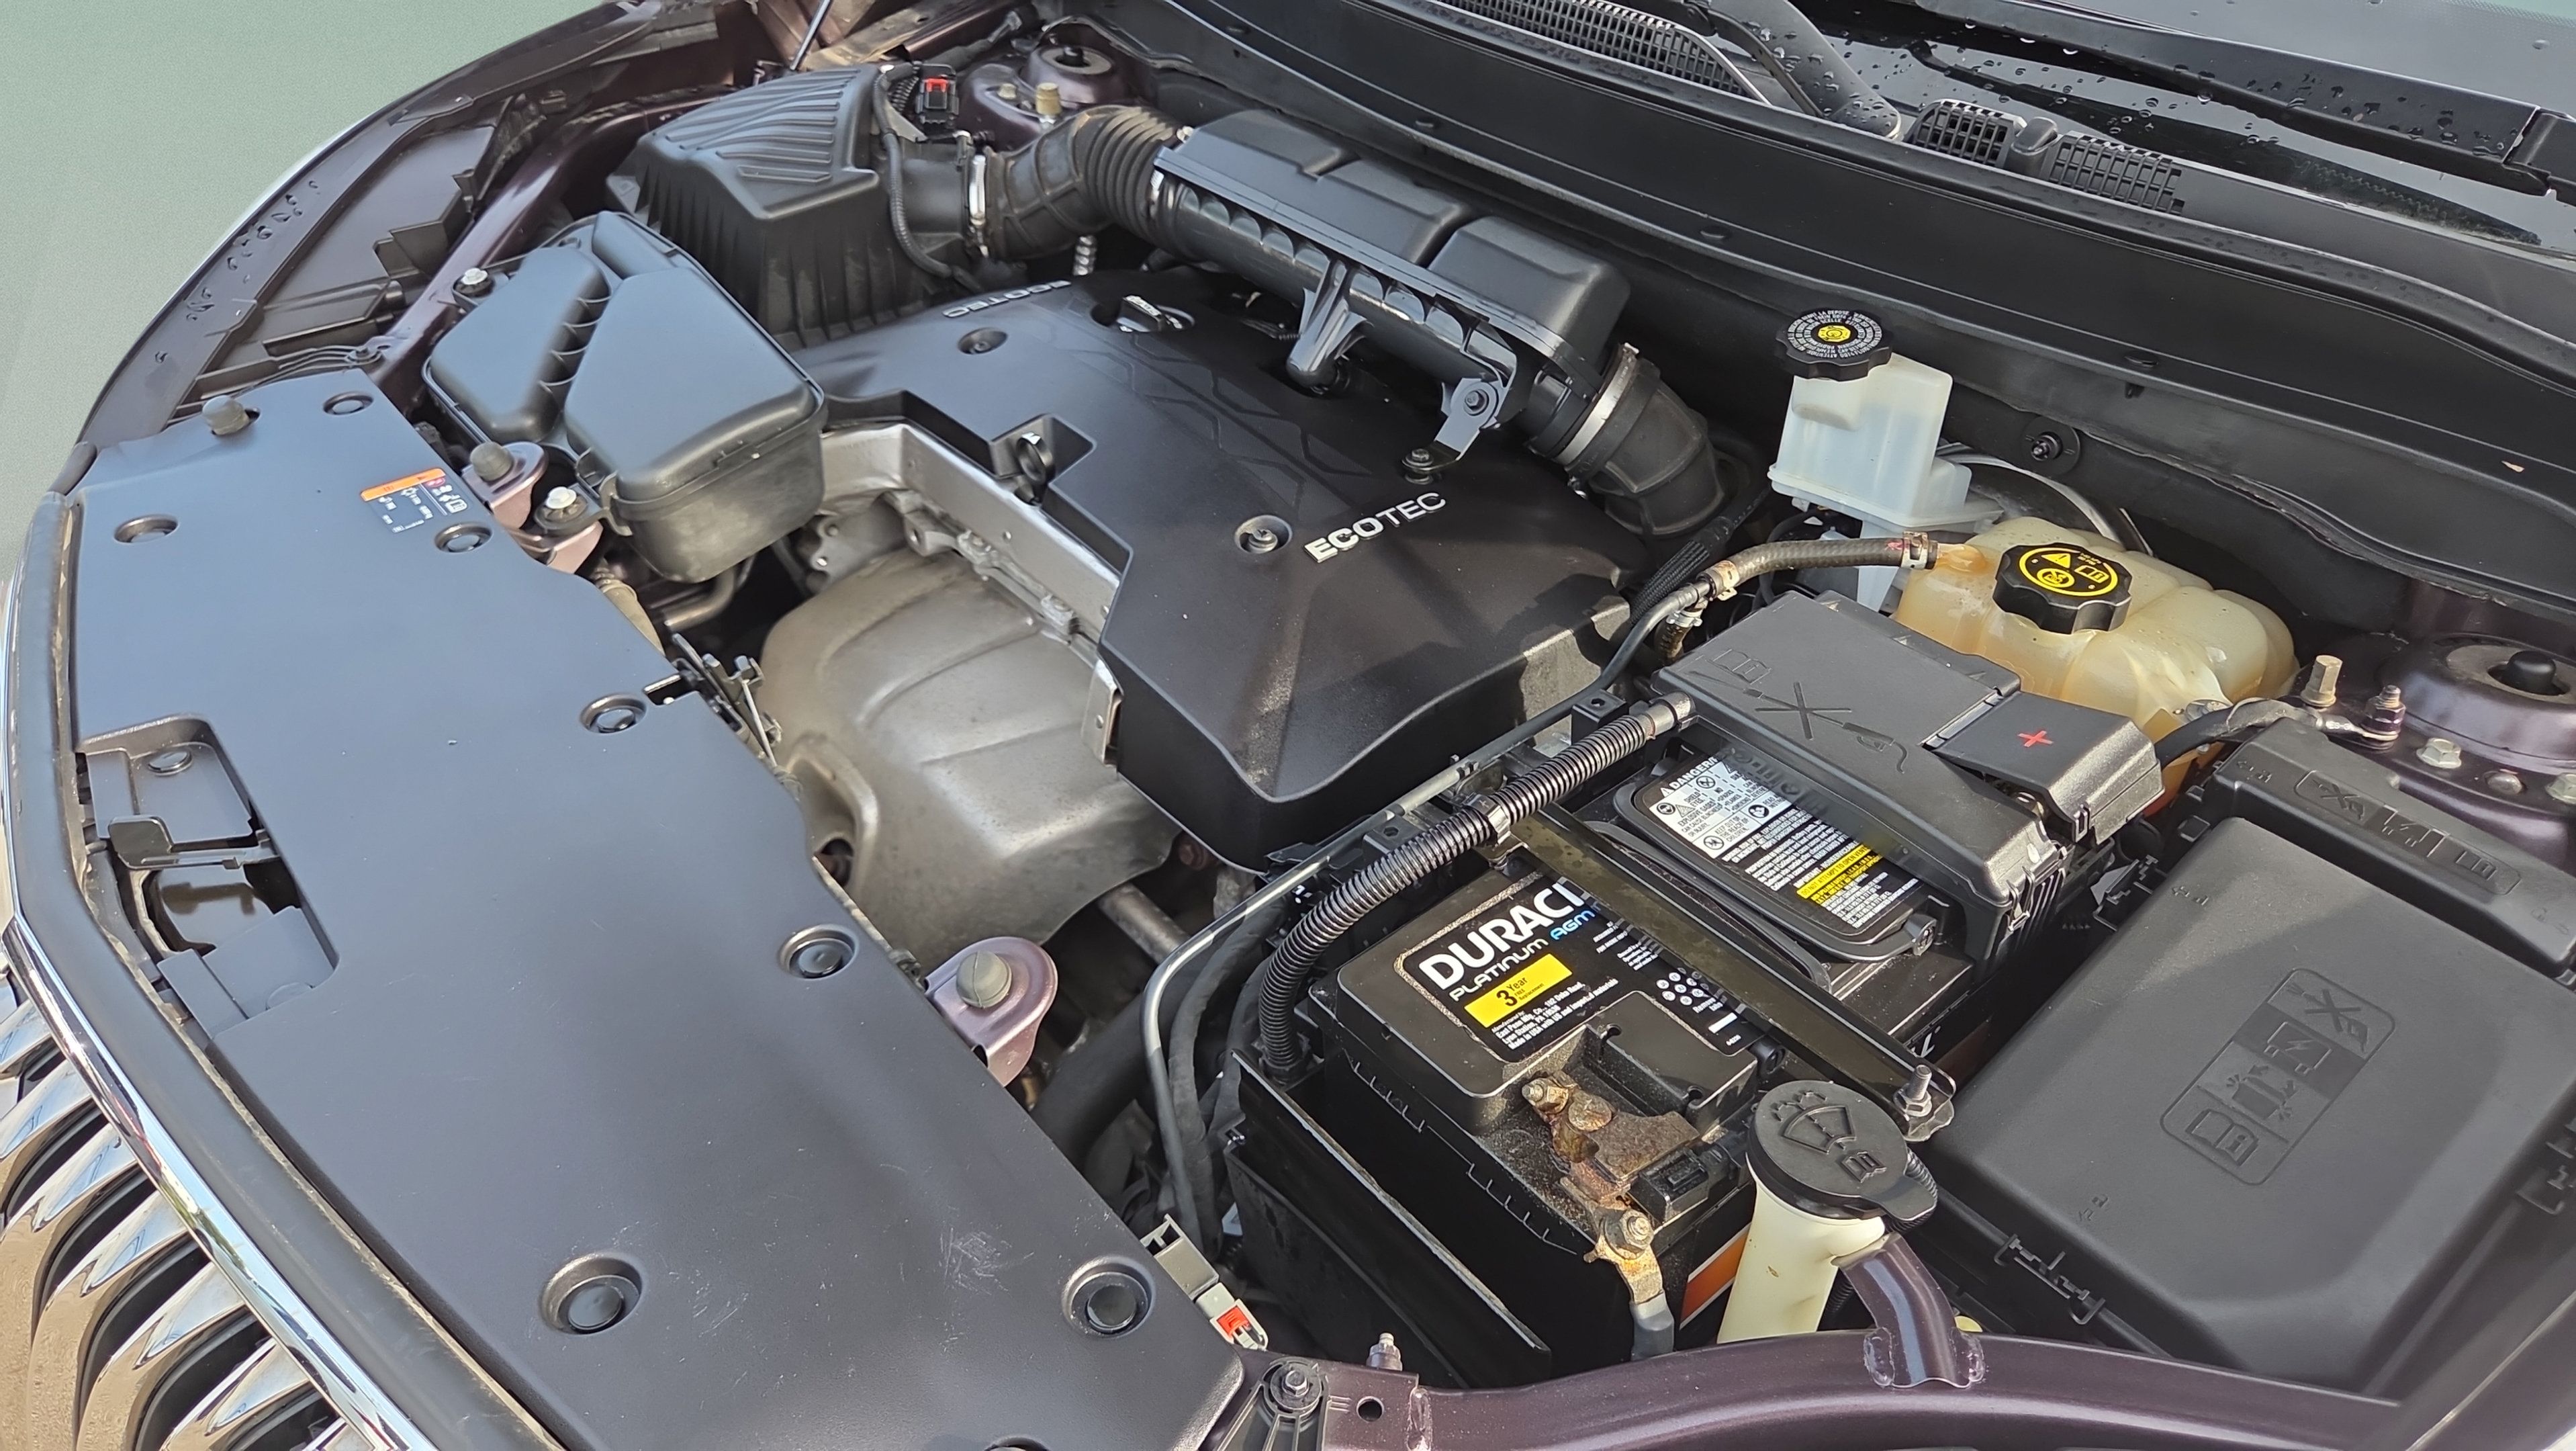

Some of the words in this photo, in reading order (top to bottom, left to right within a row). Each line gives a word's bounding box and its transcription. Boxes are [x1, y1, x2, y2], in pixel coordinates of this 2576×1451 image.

[1303, 492, 1446, 563] ECOTEC
[1807, 881, 1819, 889] NOT
[1816, 867, 1839, 883] ATTEMPT
[1841, 854, 1855, 865] OPEN
[1449, 938, 1549, 1002] PLATINUM
[1551, 909, 1595, 940] AGM
[1496, 990, 1518, 1006] 3
[1506, 977, 1528, 992] Year
[1495, 1028, 1511, 1039] East
[1507, 1019, 1524, 1030] Penn
[1520, 1012, 1536, 1022] Mfg.
[1544, 998, 1557, 1006] 102
[1553, 990, 1570, 1001] Deka
[1567, 981, 1585, 993] Road,
[1507, 1037, 1526, 1049] Made
[1528, 1026, 1544, 1036] USA
[1540, 1018, 1555, 1028] with
[1559, 1006, 1573, 1016] and
[1569, 993, 1596, 1010] imported
[1592, 978, 1620, 996] materials
[1692, 996, 1717, 1012] Remove
[1501, 1032, 1518, 1044] Lyon
[1514, 1020, 1537, 1035] Station,
